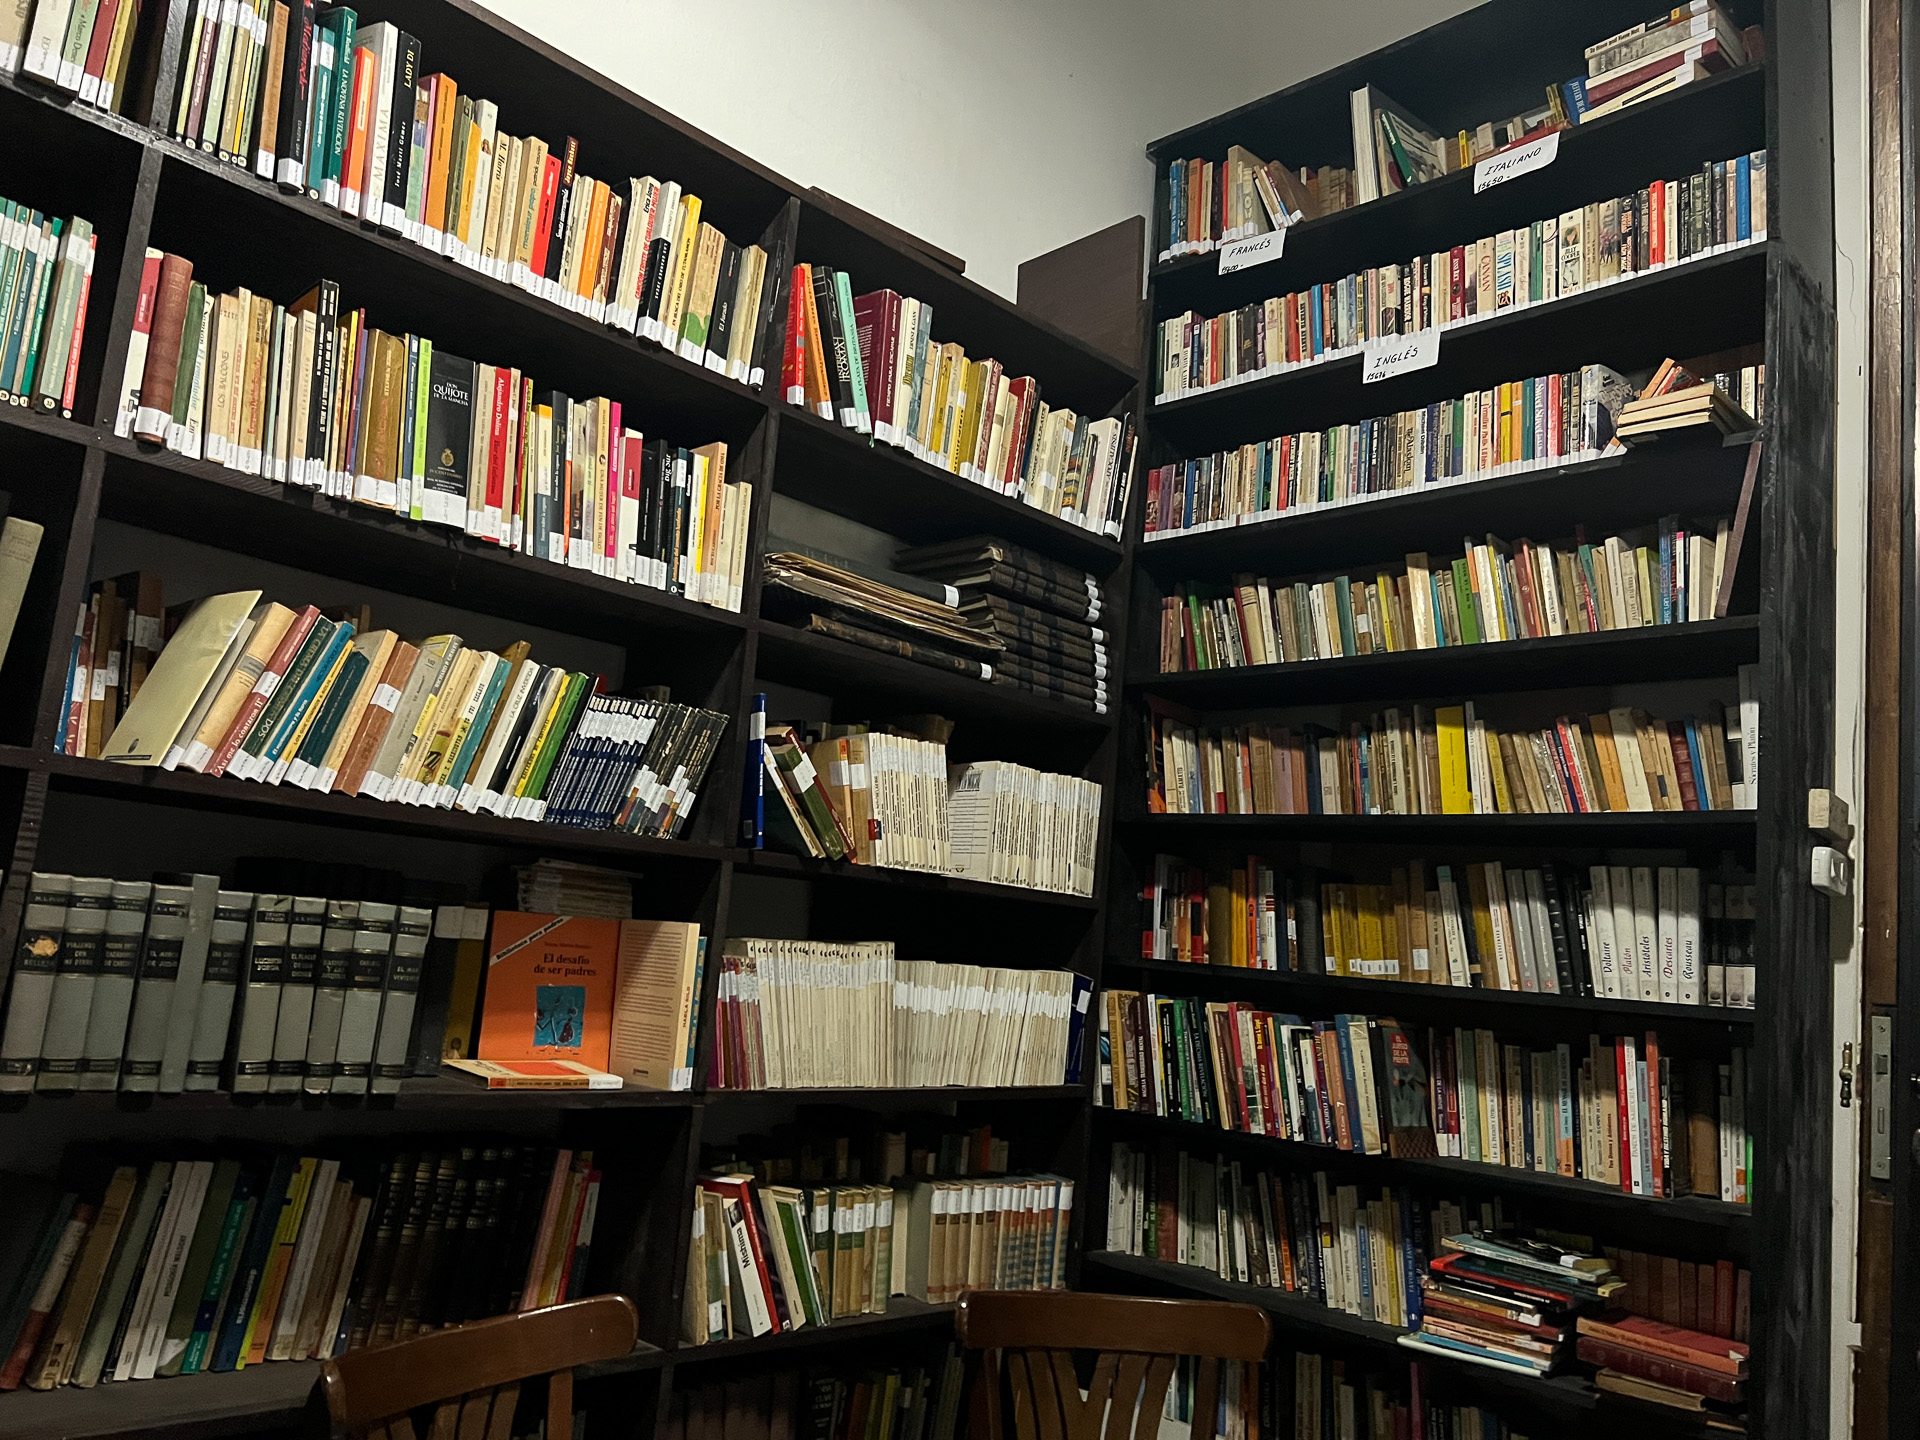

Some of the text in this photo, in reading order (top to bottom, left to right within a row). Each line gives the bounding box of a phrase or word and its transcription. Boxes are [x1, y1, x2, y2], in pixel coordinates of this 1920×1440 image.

[341, 68, 349, 78] LA
[402, 49, 415, 88] LADY DI
[1484, 147, 1542, 176] ITALIANO
[640, 182, 656, 213] Erica Jong
[1640, 201, 1649, 214] THE
[519, 187, 537, 250] monsieur papa
[1229, 238, 1271, 258] FRANCÉS
[1479, 254, 1493, 292] CANAAN
[1494, 251, 1513, 290] SPLASH
[672, 299, 680, 318] BUSCA
[717, 301, 729, 331] El Jurado
[848, 323, 859, 354] BRITANIA
[887, 336, 896, 364] ESCAPAR
[843, 339, 851, 379] ROMA
[1374, 345, 1418, 368] INGLÉS
[190, 348, 205, 411] El rematador
[217, 350, 230, 408] LOS BALCONES
[854, 365, 863, 386] PLATA
[433, 384, 469, 400] QUIJOTE
[493, 377, 505, 436] Alejandro Dolina
[884, 383, 892, 407] TIEMPO
[1402, 438, 1416, 472] Alaskan
[433, 664, 448, 688] RICHARD
[512, 694, 522, 711] CRUZ
[519, 666, 534, 694] INVERTIDA
[225, 706, 259, 759] me lo contaron
[293, 734, 301, 745] LOS
[299, 723, 307, 733] QUE
[1746, 726, 1756, 749] Platón
[1748, 755, 1757, 785] Sócrates
[496, 940, 528, 960] Biblioteca
[528, 930, 543, 942] para
[544, 953, 590, 965] El desafío
[1639, 936, 1651, 977] Aristóteles
[1662, 937, 1672, 978] Descartes
[1681, 939, 1696, 980] Rousseau
[533, 964, 546, 974] de
[564, 966, 597, 978] padres
[1620, 947, 1634, 974] Platón
[736, 1227, 750, 1269] Mishima
